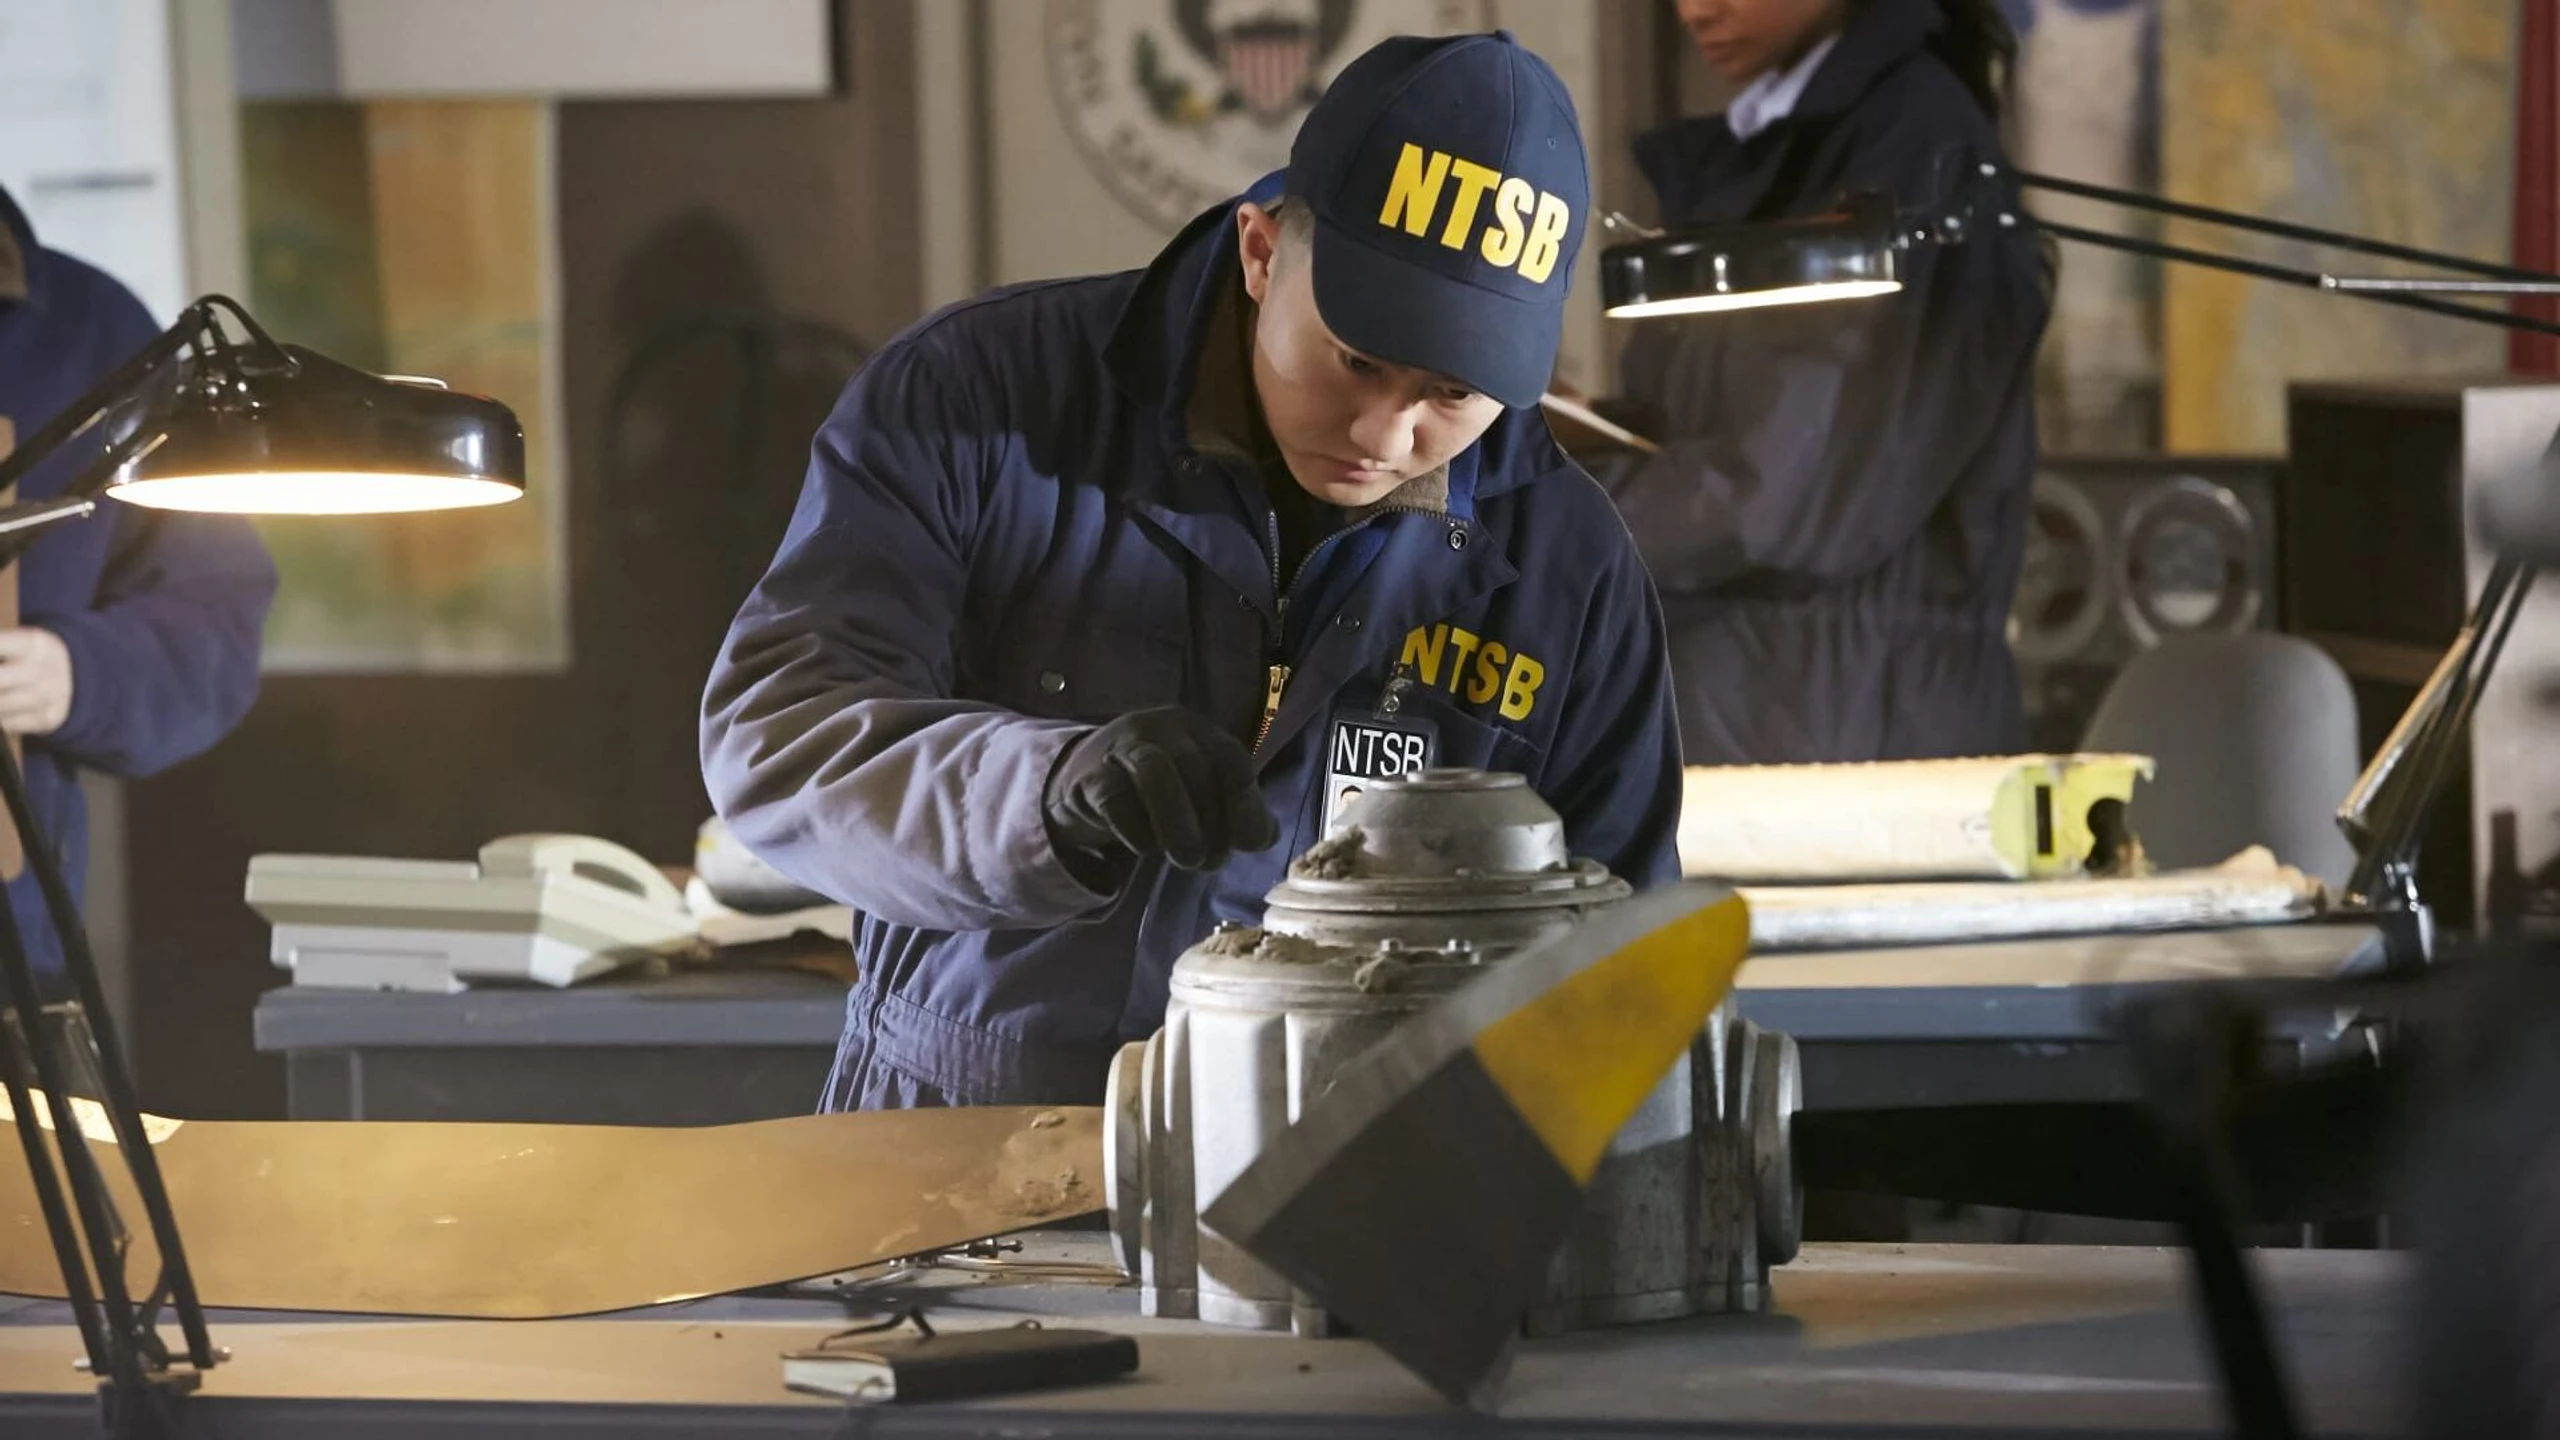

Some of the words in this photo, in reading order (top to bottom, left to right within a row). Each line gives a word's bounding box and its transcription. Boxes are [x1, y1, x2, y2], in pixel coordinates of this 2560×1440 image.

[1379, 142, 1569, 284] NTSB
[1401, 624, 1544, 721] NTSB
[1336, 725, 1425, 775] NTSB
